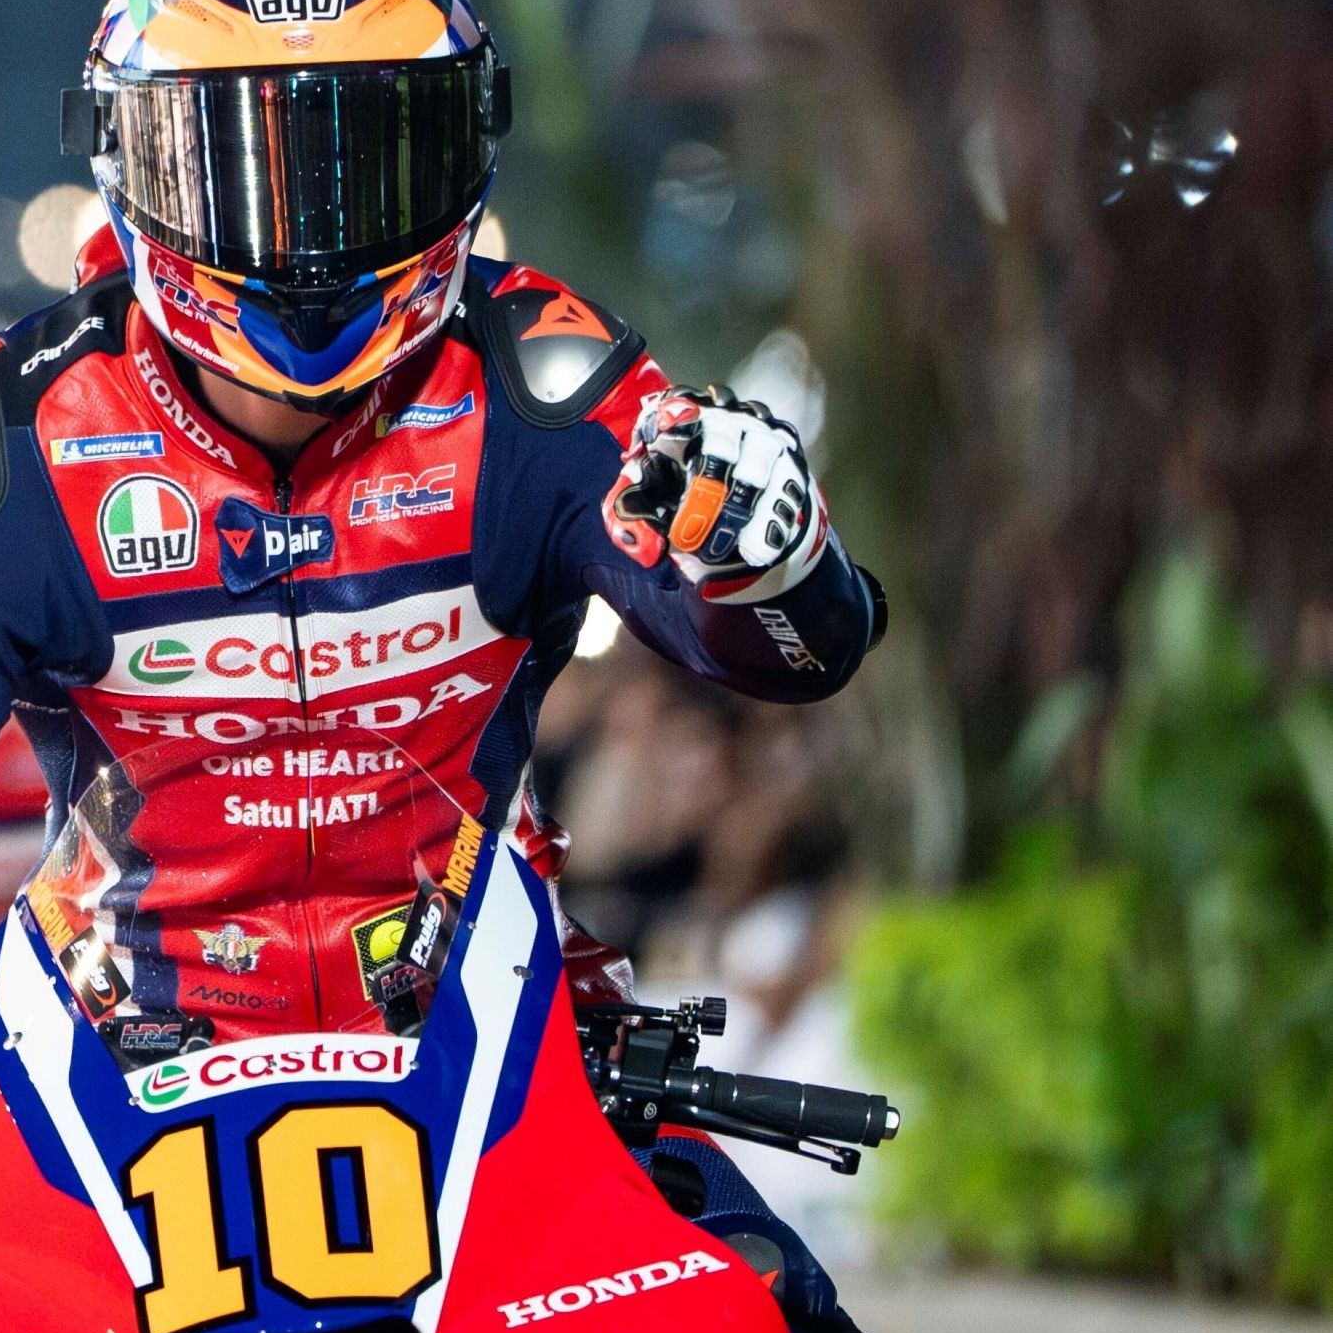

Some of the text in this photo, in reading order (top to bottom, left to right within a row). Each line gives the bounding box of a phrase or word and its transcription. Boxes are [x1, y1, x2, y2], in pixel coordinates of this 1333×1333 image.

[21, 316, 105, 376] DAINESE
[133, 348, 238, 469] HONDA
[84, 440, 154, 455] MICHELIN
[349, 463, 456, 519] HRC
[402, 503, 455, 519] RACING
[115, 531, 187, 571] agv
[205, 606, 462, 684] Castrol
[114, 672, 493, 745] HONDA
[201, 746, 404, 778] One HEART.
[223, 794, 293, 828] Satu
[27, 880, 74, 951] MARINI
[410, 903, 442, 966] Puig
[120, 1023, 182, 1044] HRC
[200, 1043, 405, 1089] Castrol
[497, 1250, 729, 1327] HONDA
